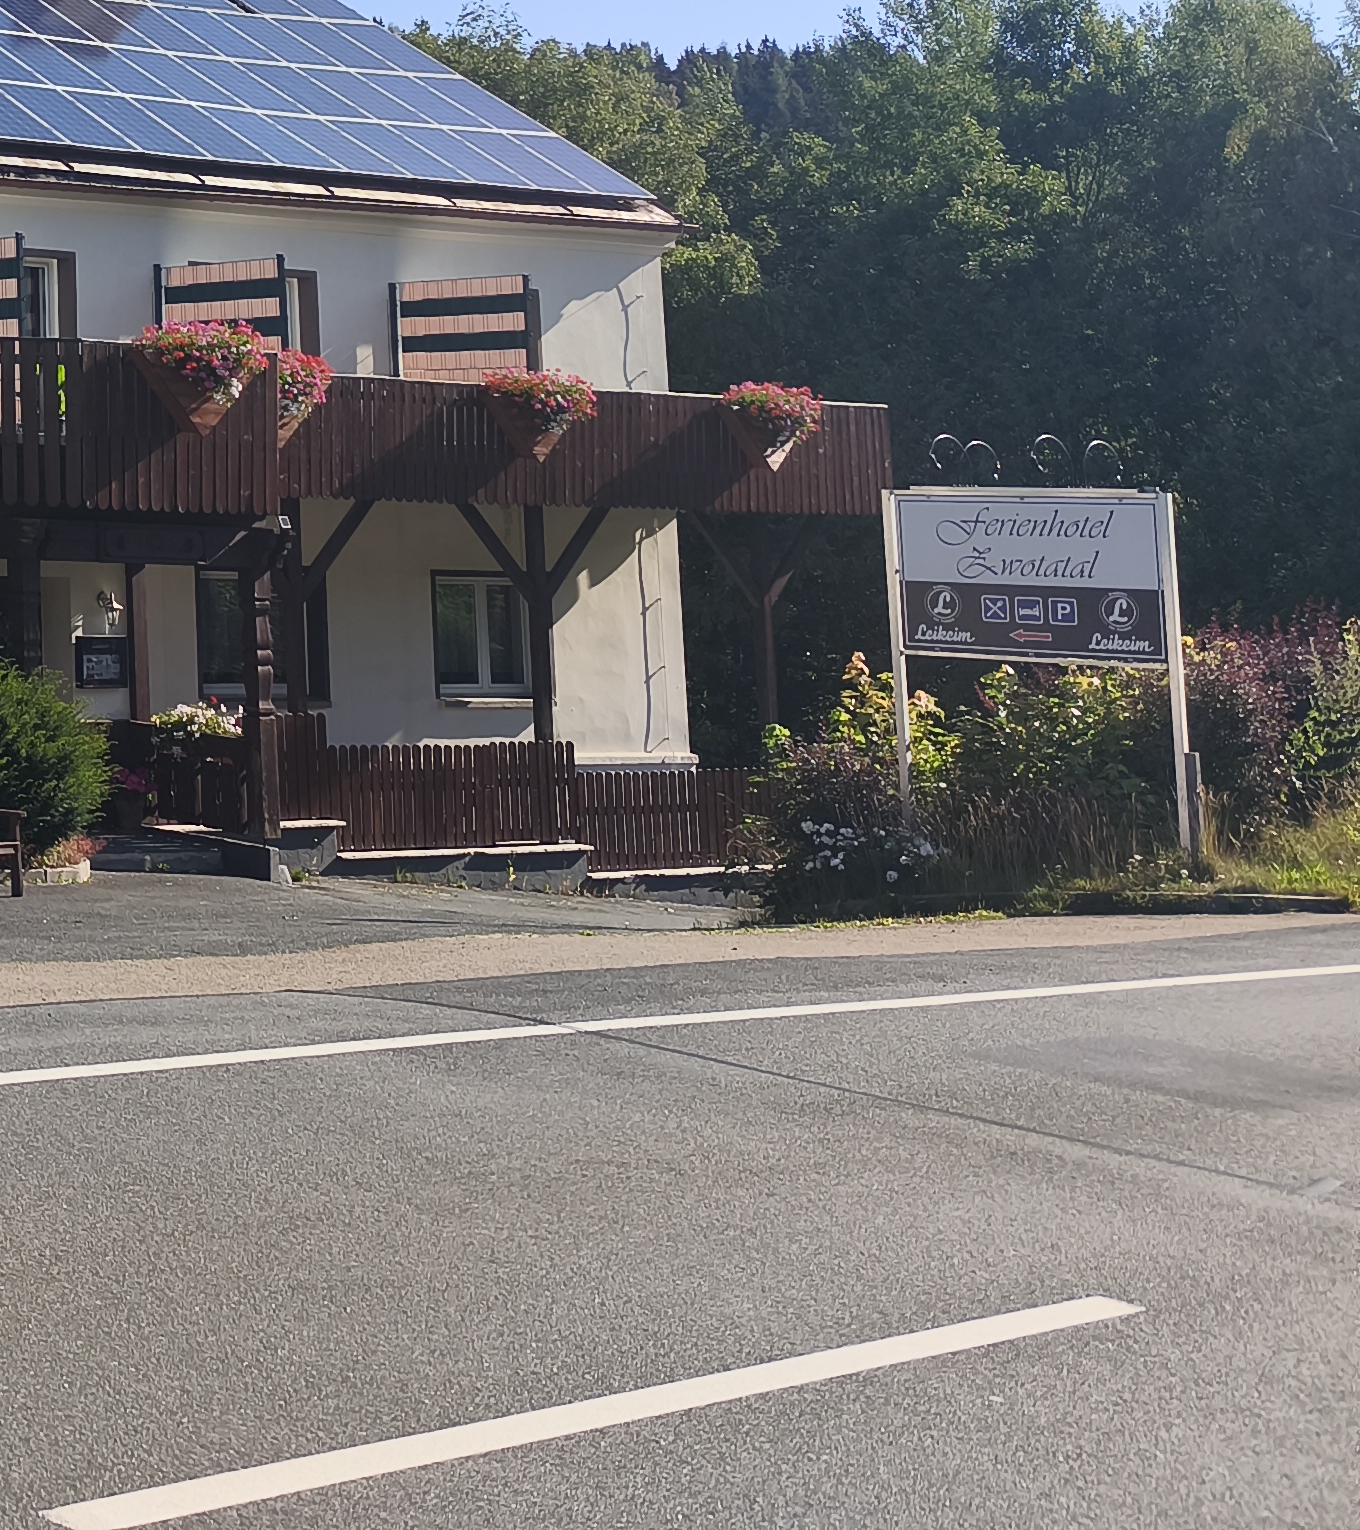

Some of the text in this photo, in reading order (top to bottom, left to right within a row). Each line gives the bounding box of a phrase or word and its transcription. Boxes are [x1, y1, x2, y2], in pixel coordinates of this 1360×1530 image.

[936, 507, 1114, 546] Ferienhotel
[956, 546, 1100, 579] Zwotatal
[1057, 604, 1071, 620] P
[914, 623, 975, 642] Leikeim
[1088, 632, 1154, 651] Leikeim
